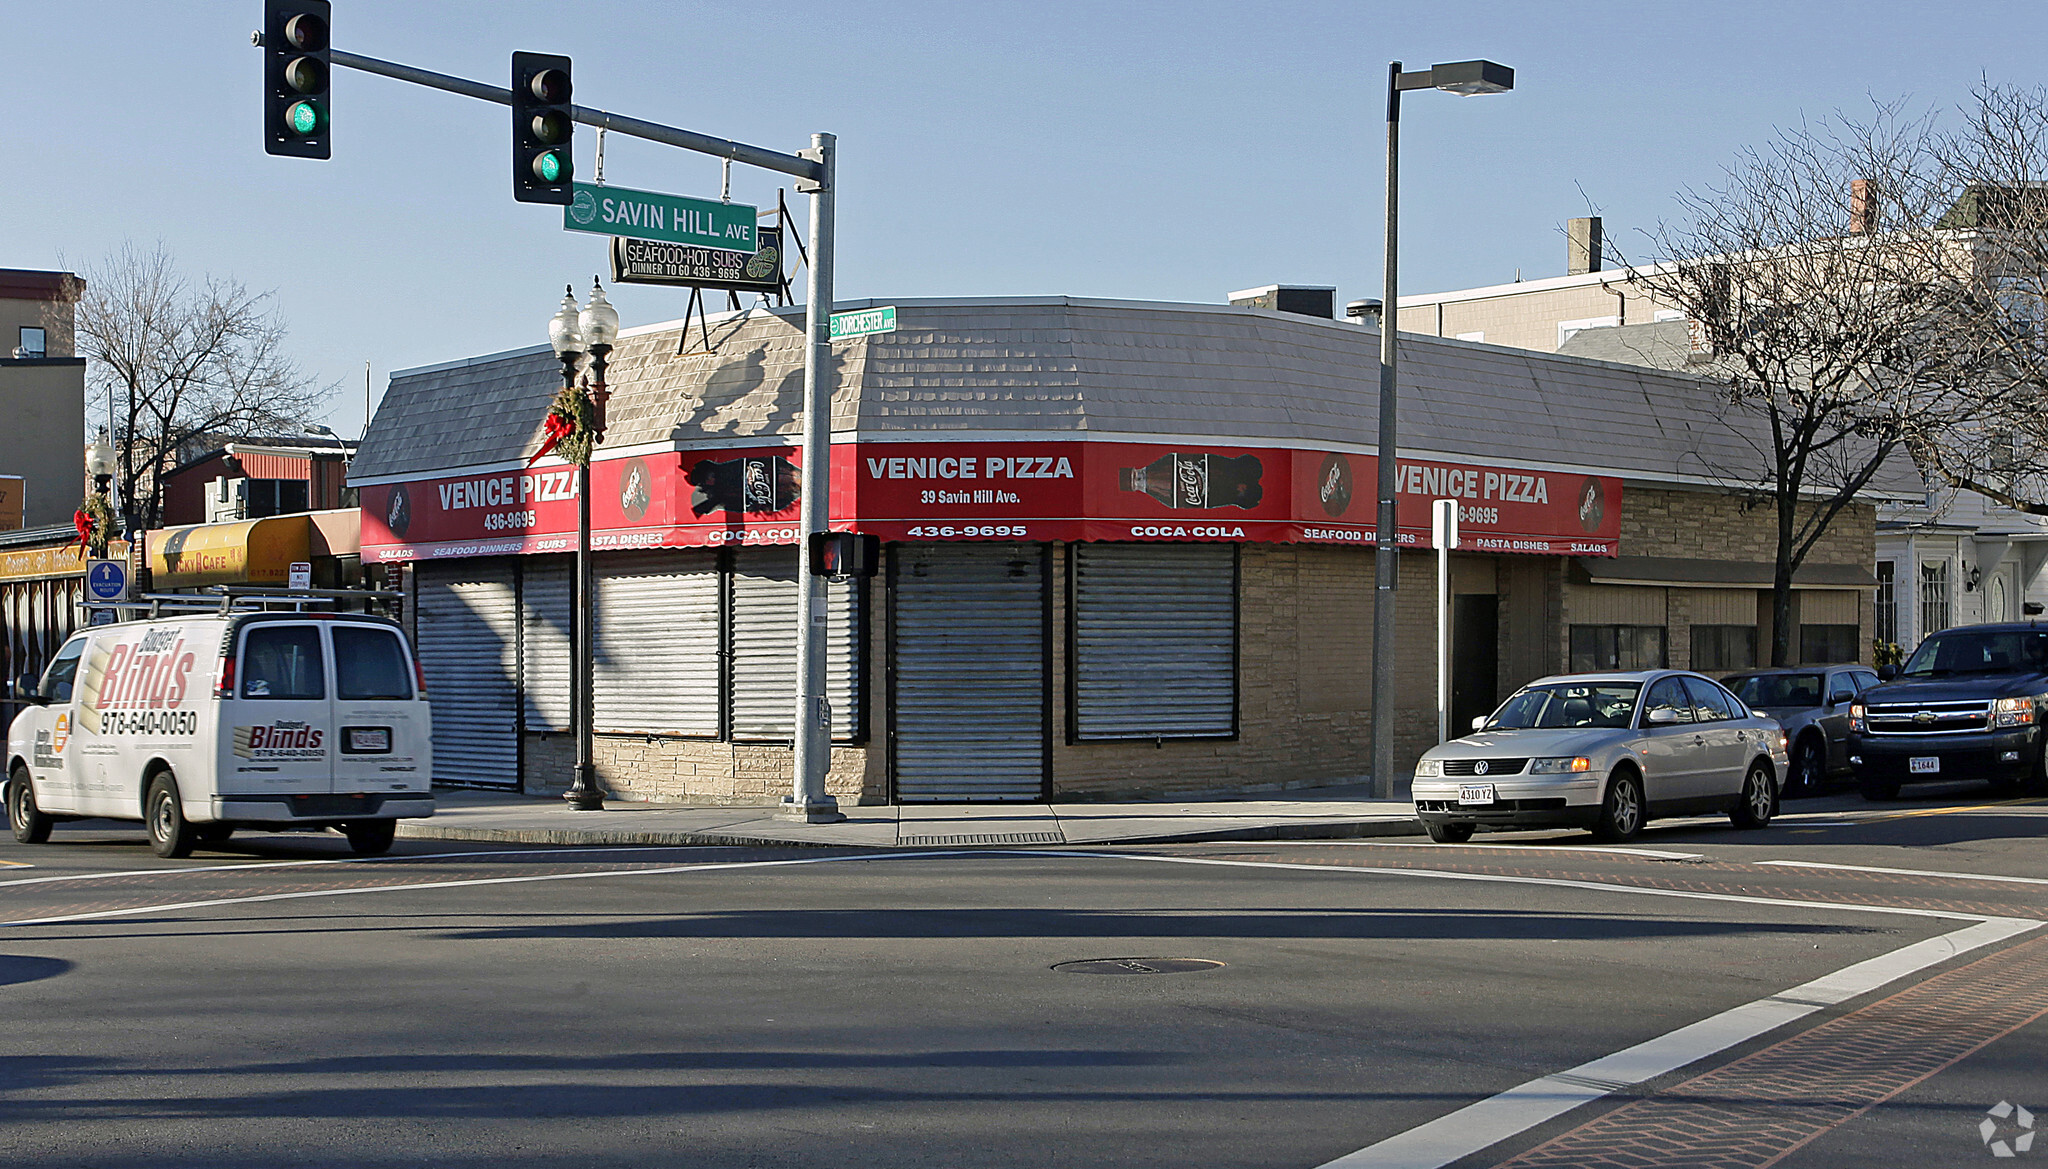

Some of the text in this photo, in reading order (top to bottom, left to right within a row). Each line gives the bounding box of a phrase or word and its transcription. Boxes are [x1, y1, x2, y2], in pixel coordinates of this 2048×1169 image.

[602, 198, 664, 230] SAVIN
[673, 207, 720, 237] HILL
[725, 223, 750, 240] AVE
[632, 263, 663, 275] DINNER
[666, 264, 677, 275] TO
[678, 265, 690, 276] GO
[712, 251, 743, 269] SUBS
[839, 311, 895, 334] DORCHESTER AVE
[866, 456, 1074, 479] VENICE PIZZA
[438, 478, 514, 511] VENICE
[1395, 464, 1549, 504] VENICE PIZZA
[920, 489, 1021, 504] 39 Savin Hill Ave.
[484, 510, 537, 531] 436-9695
[907, 526, 1028, 537] 436-9695
[432, 546, 478, 556] SEAFOOD
[478, 542, 523, 554] DINNERS
[536, 539, 567, 549] SUBS
[1303, 528, 1362, 540] SEAFOOD
[1476, 538, 1511, 549] PASTA
[1513, 540, 1550, 551] DISHES
[1570, 543, 1608, 553] SALADS
[203, 555, 227, 570] CAFE
[378, 549, 414, 559] SALADS
[138, 626, 183, 653] Budget
[96, 638, 195, 710] Blinds
[101, 711, 197, 736] 978-640-0050
[248, 725, 324, 749] Blinds
[255, 749, 326, 757] 978-640-0050
[1460, 789, 1492, 800] 4310 YZ
